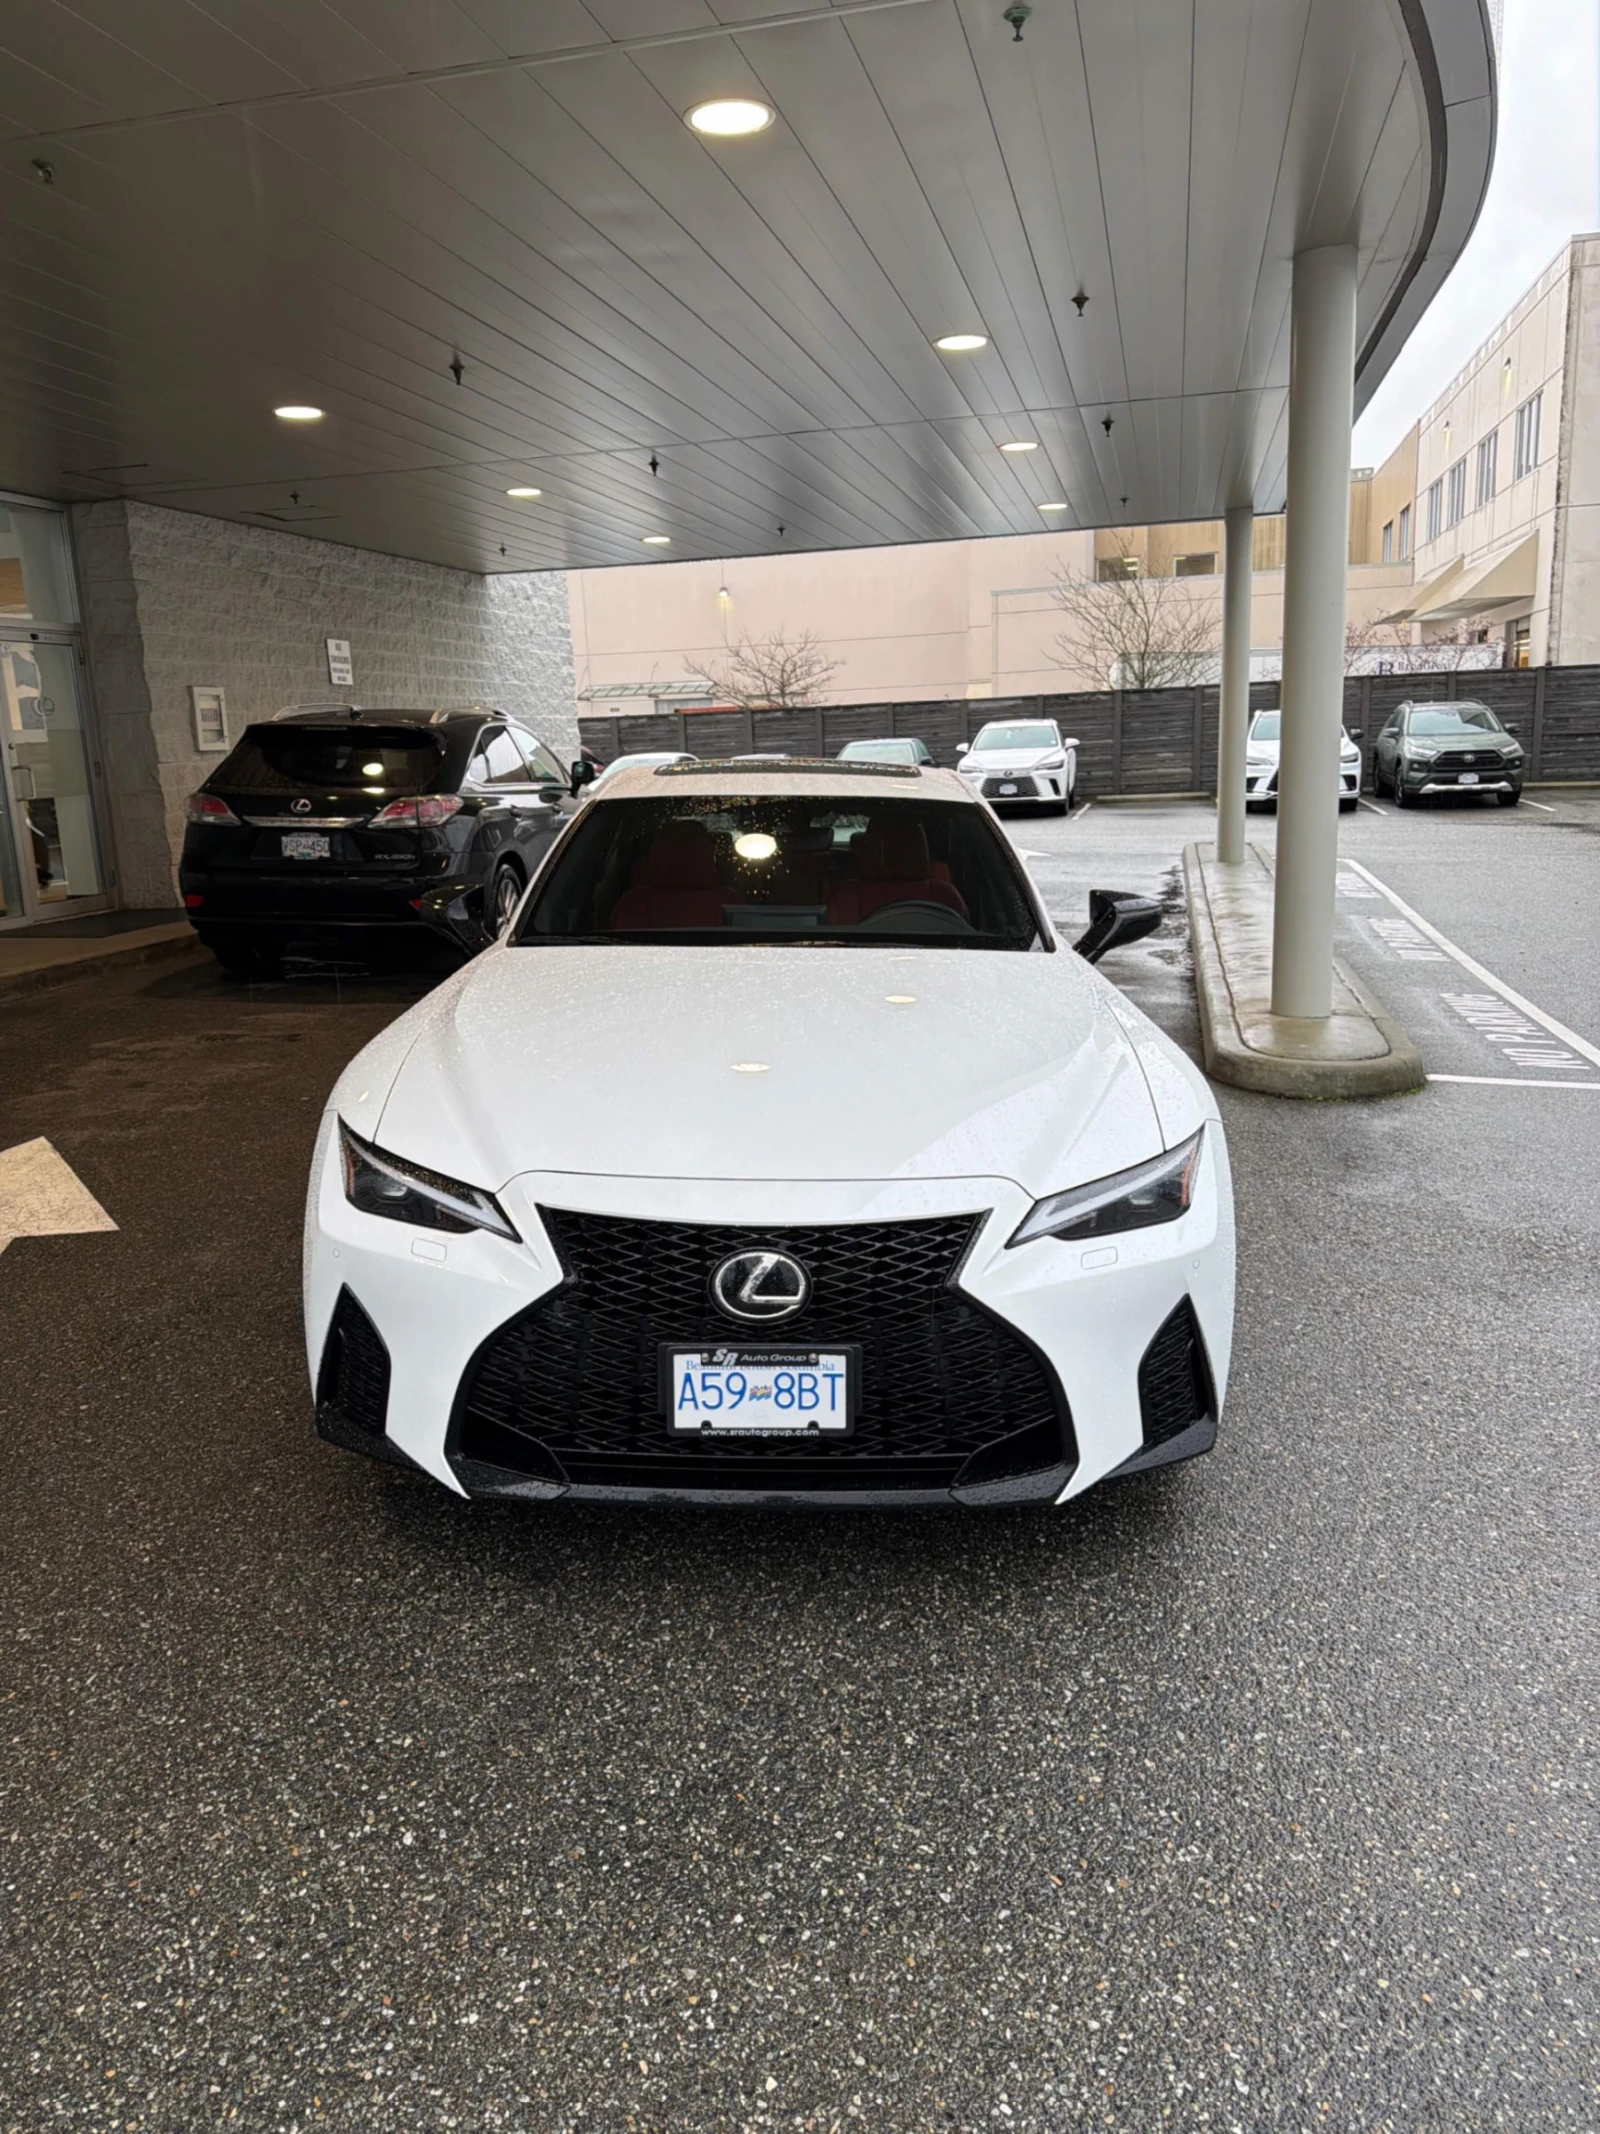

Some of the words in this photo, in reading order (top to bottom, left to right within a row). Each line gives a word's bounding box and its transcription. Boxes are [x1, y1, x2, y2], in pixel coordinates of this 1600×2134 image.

[1439, 993, 1558, 1044] PARKING
[1502, 1048, 1591, 1070] NO
[740, 1354, 769, 1362] Auto
[770, 1353, 807, 1362] Group
[677, 1372, 748, 1410] A59
[773, 1372, 844, 1411] 8BT
[701, 1428, 820, 1438] www.srautogroup.com
